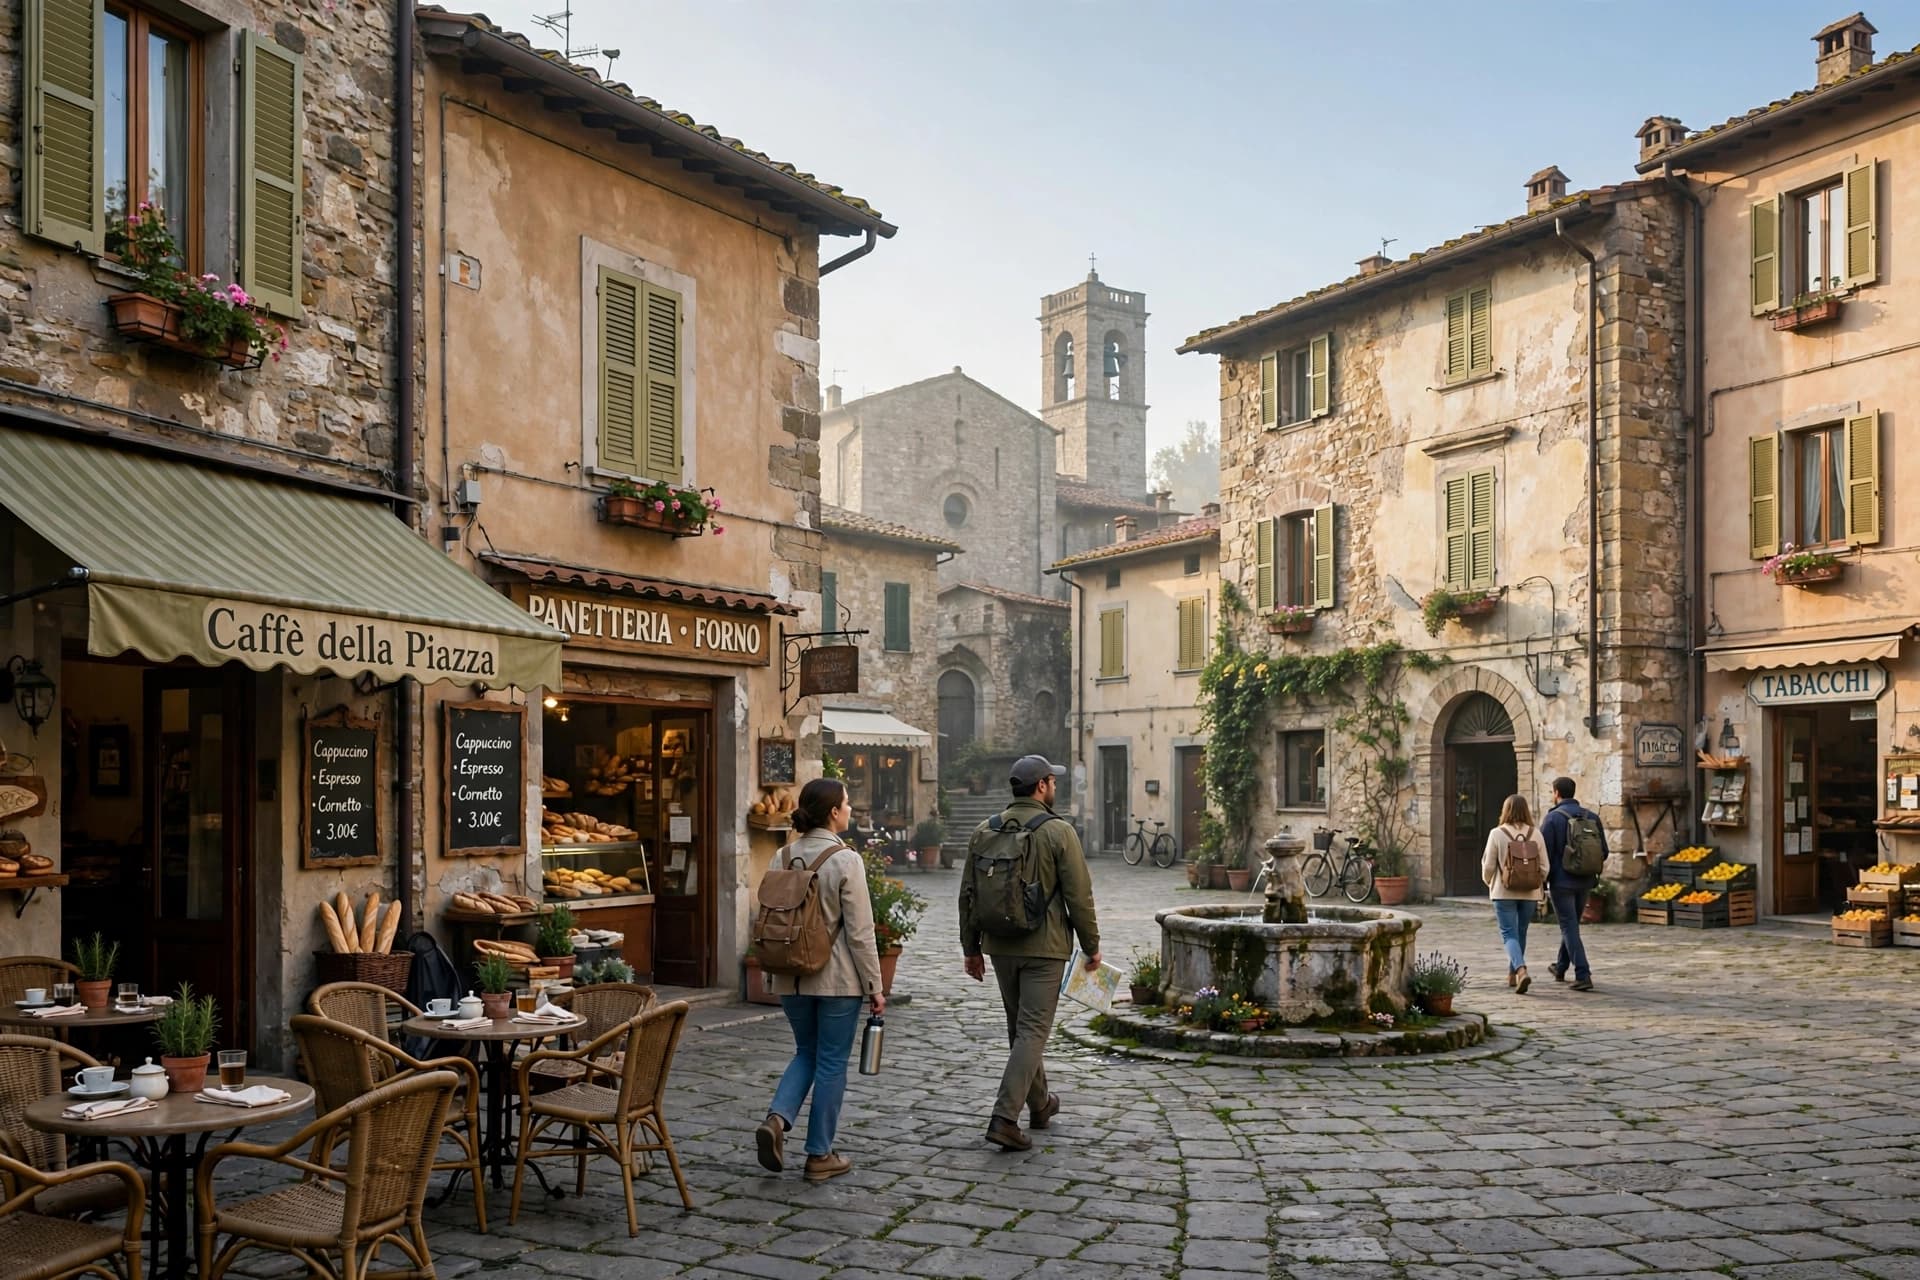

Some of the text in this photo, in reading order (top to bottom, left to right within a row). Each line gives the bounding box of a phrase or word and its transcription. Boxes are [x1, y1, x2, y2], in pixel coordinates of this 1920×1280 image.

[529, 595, 761, 654] PANETTERIA FORNO
[208, 607, 495, 676] Caffè della Piazza
[1762, 669, 1870, 698] TABACCHI
[314, 739, 369, 764] Cappuccino
[456, 732, 512, 755] Cappuccino
[318, 768, 361, 790] Espresso
[460, 758, 504, 780] Espresso
[458, 784, 503, 801] Cornetto
[318, 795, 362, 813] Cornetto
[468, 811, 502, 829] 3.00€
[326, 823, 359, 841] 3.00€
